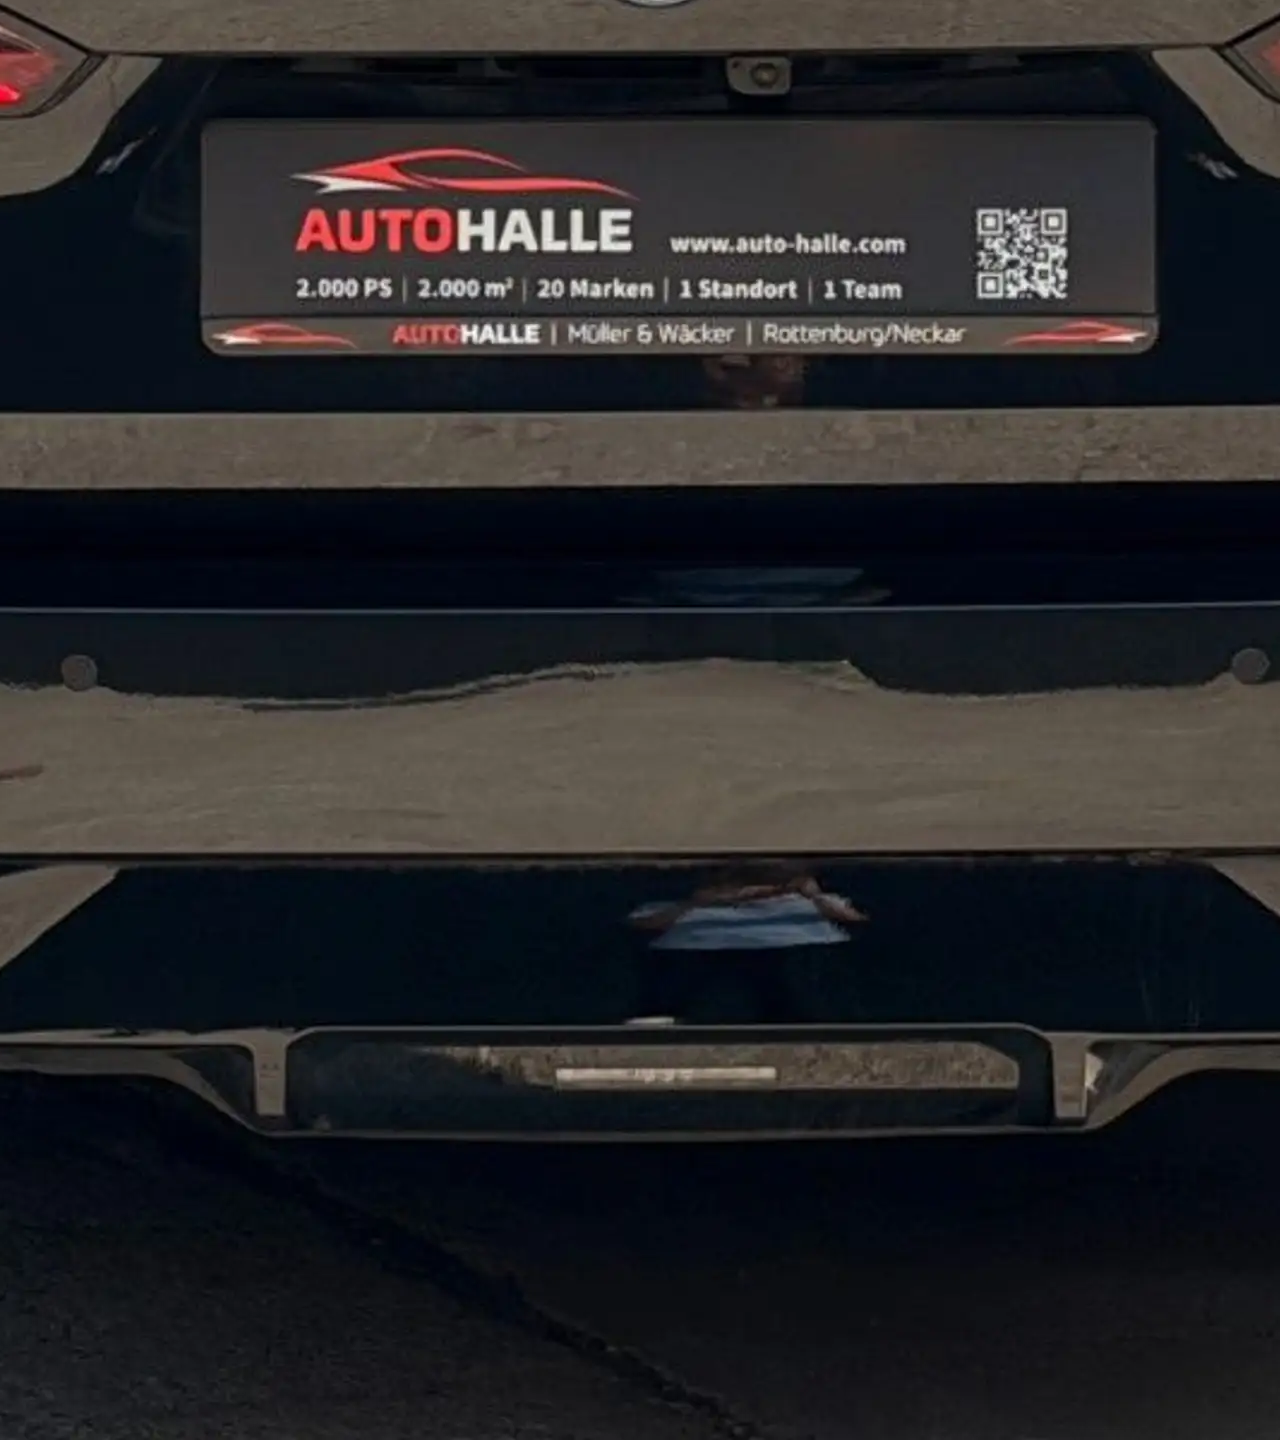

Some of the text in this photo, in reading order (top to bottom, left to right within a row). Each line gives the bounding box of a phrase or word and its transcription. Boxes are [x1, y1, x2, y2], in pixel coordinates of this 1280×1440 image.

[296, 209, 632, 252] AUTOHALLE
[670, 234, 907, 254] www.auto-halle.com
[296, 278, 358, 298] 2.000
[364, 278, 393, 298] PS
[418, 278, 480, 298] 2.000
[537, 279, 564, 298] 20
[570, 278, 654, 298] Marken
[679, 279, 692, 298] 1
[698, 279, 797, 299] Standort
[823, 280, 837, 299] 1
[842, 280, 902, 299] Team
[393, 321, 967, 347] AUTOHALLE Müller & Wäcker Rottenburg/Neckar
